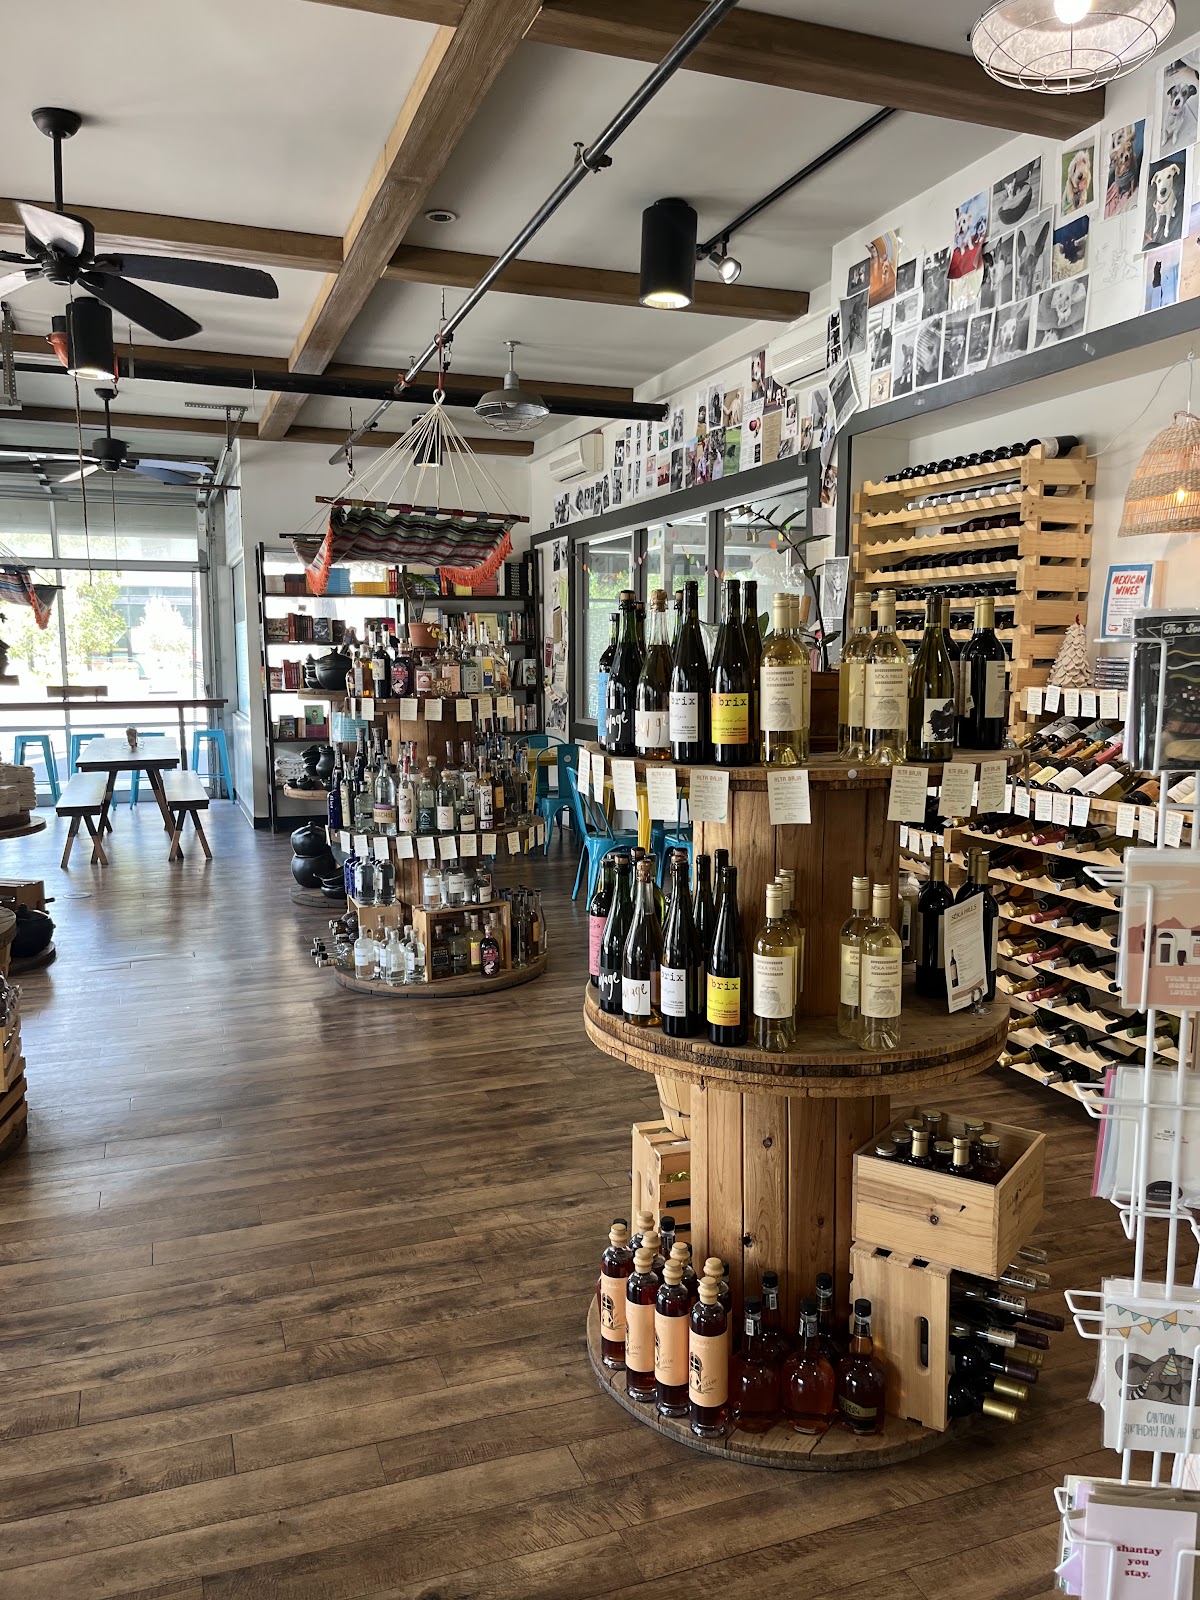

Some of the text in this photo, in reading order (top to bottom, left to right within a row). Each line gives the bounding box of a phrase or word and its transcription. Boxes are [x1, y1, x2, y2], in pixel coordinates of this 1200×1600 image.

[1112, 575, 1146, 585] MEXICAN
[1115, 586, 1140, 595] WINES
[1163, 623, 1183, 635] The
[718, 697, 747, 707] brix
[711, 979, 739, 991] brix
[1147, 1411, 1177, 1425] CAUTION:
[1123, 1423, 1159, 1437] BIRTHDAY
[1160, 1425, 1176, 1438] FUN
[1116, 1543, 1162, 1557] shantay
[1127, 1558, 1149, 1566] you
[1124, 1569, 1151, 1579] stay.
